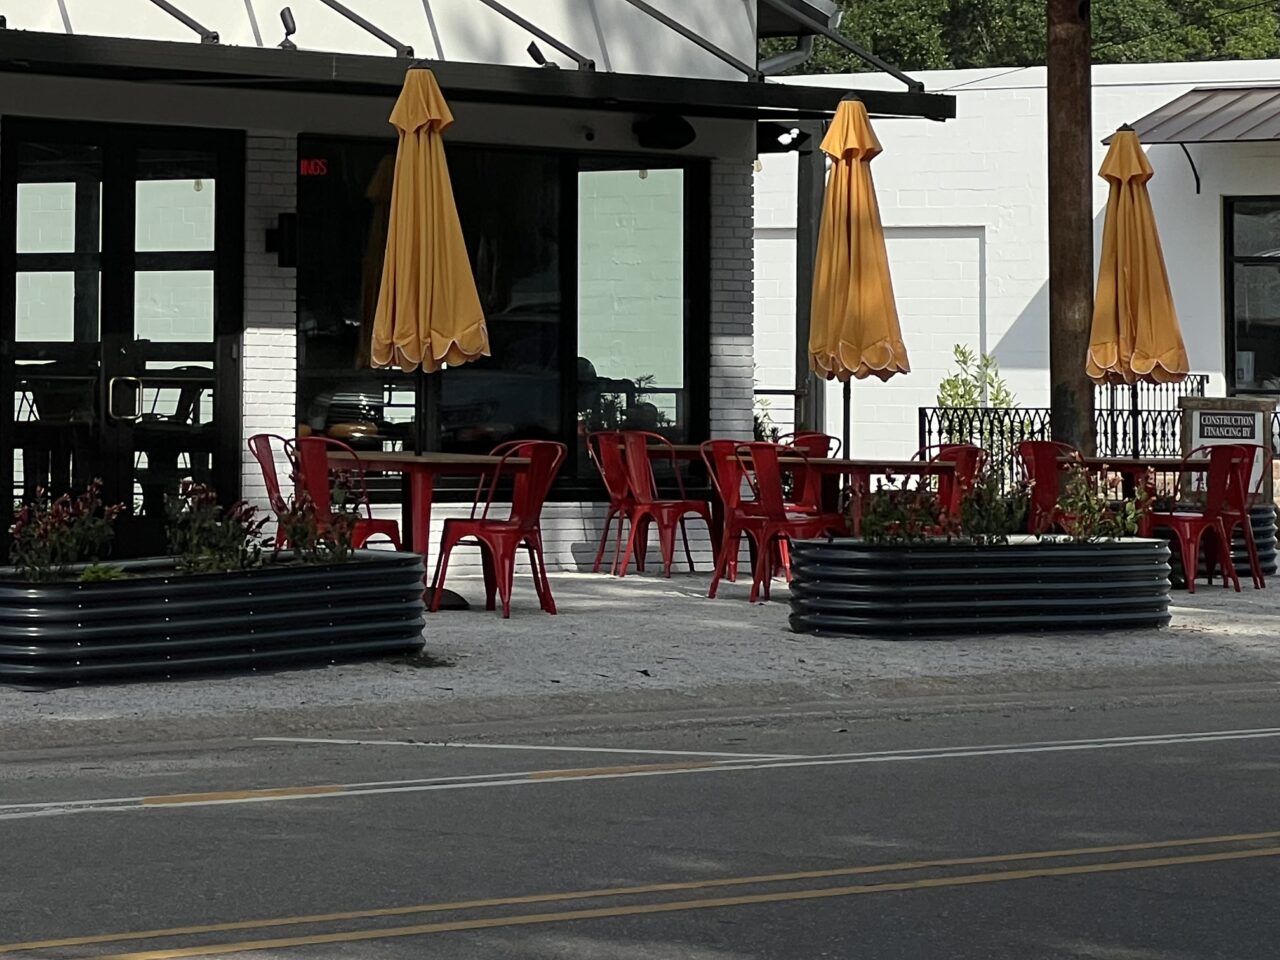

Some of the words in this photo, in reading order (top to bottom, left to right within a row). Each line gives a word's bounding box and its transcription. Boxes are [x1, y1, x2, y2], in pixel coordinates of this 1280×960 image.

[1201, 415, 1254, 425] CONSTRUCTION
[1204, 427, 1241, 437] FINANCING
[1242, 427, 1251, 437] BY
